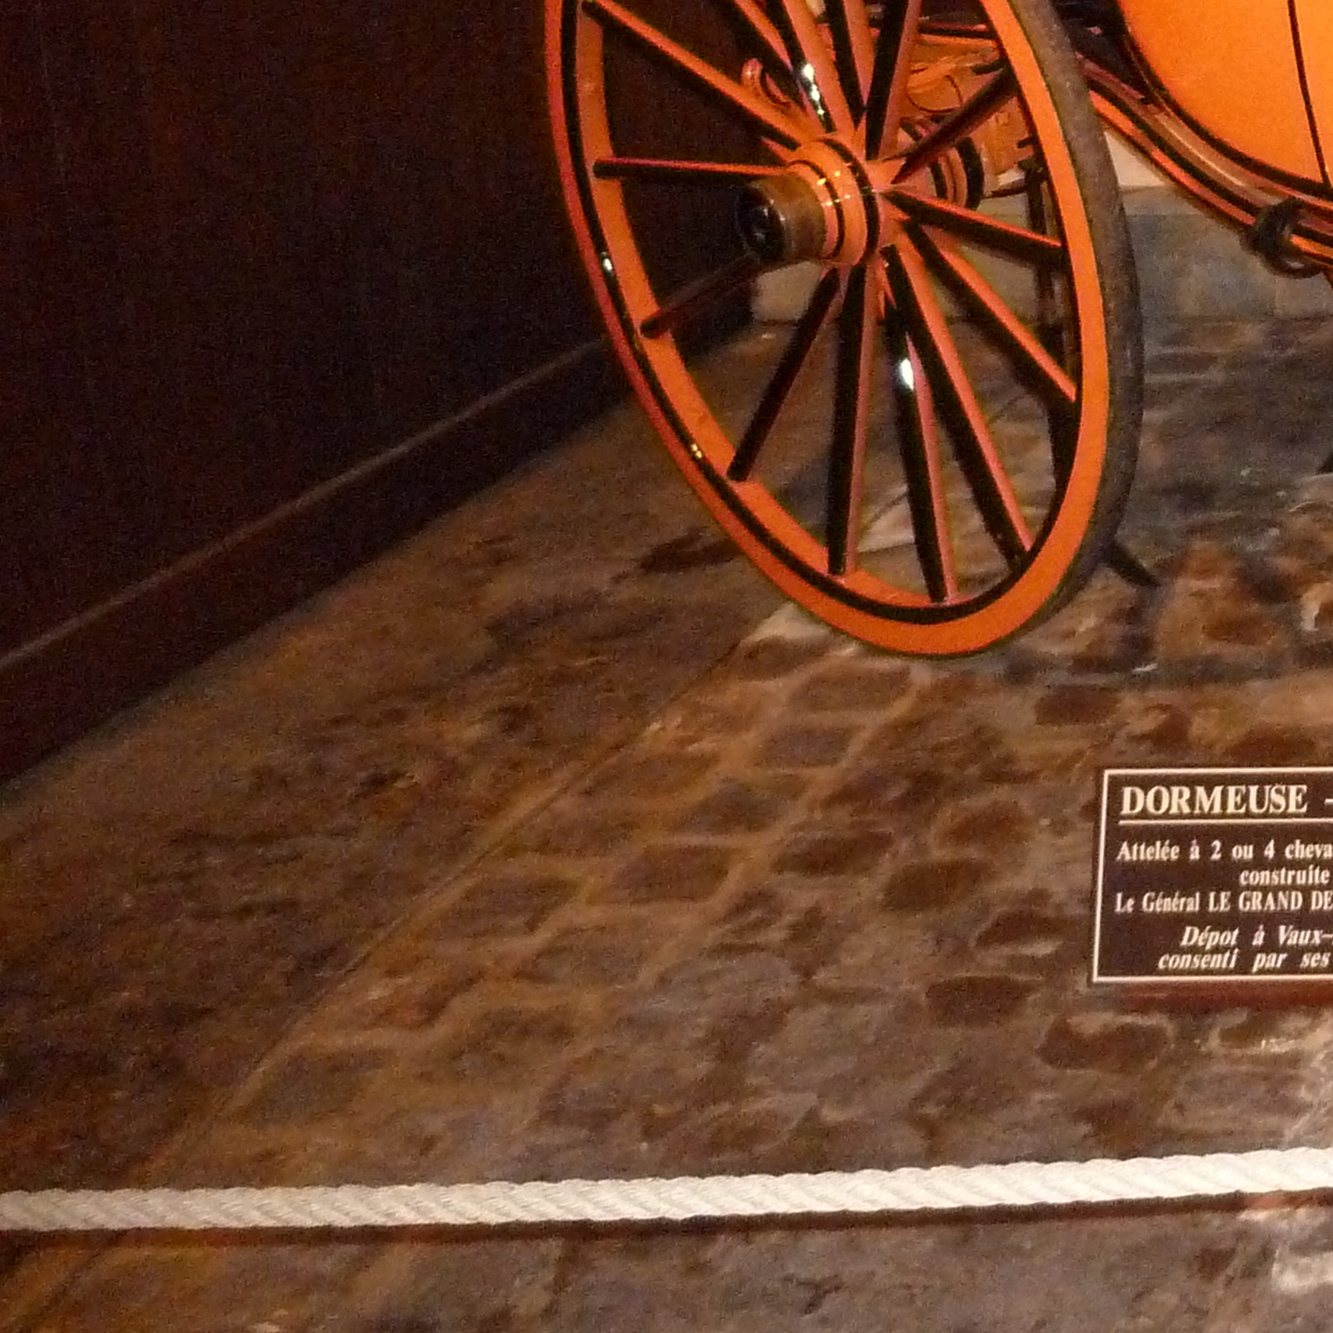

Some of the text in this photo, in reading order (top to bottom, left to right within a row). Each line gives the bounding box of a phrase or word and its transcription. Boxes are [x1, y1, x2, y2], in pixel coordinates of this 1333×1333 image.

[1120, 783, 1309, 815] DORMEUSE
[1115, 839, 1181, 862] Attelée
[1188, 838, 1201, 861] à
[1209, 839, 1223, 861] 2
[1231, 844, 1255, 861] ou
[1262, 838, 1277, 861] 4
[1238, 864, 1331, 886] construite
[1114, 891, 1136, 914] Le
[1141, 890, 1201, 914] Général
[1207, 890, 1232, 912] LE
[1238, 889, 1304, 912] GRAND
[1251, 923, 1266, 947] à
[1158, 948, 1241, 970] consenti
[1251, 951, 1289, 973] par
[1299, 951, 1332, 969] ses
